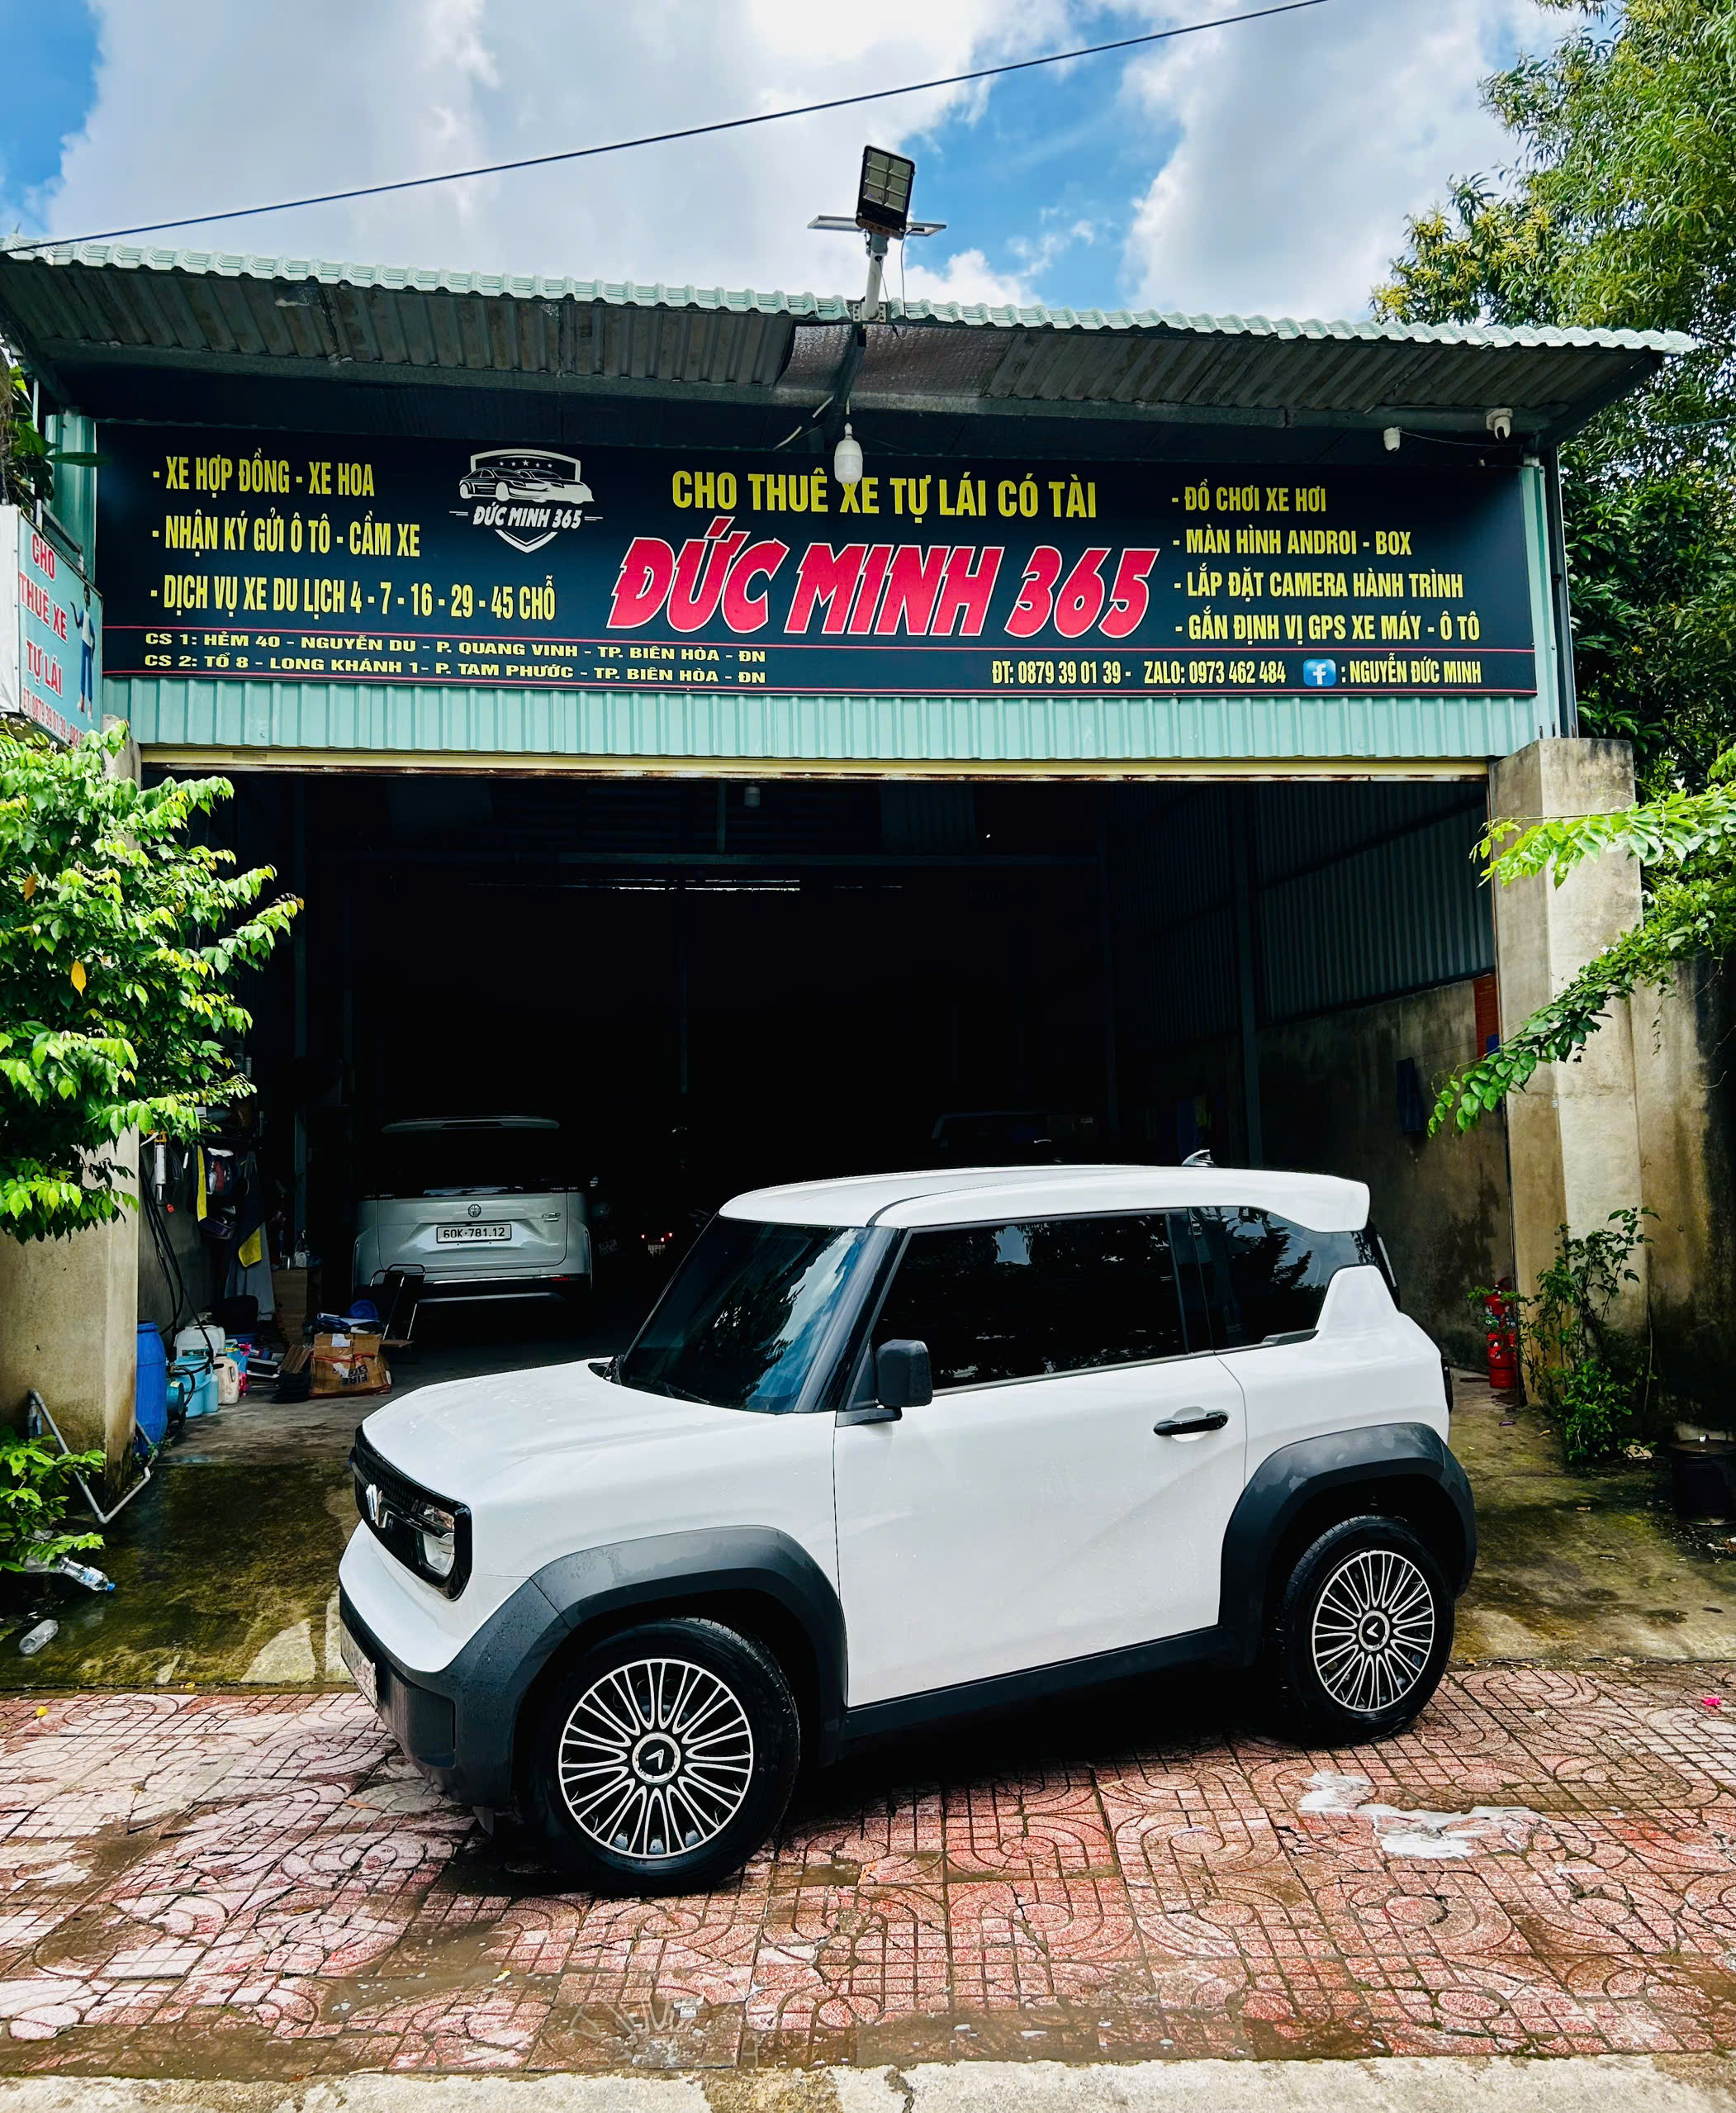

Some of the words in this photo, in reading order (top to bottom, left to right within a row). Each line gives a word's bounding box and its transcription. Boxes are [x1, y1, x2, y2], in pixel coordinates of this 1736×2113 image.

[165, 456, 190, 490] XE
[196, 454, 233, 499] HỢP
[238, 448, 290, 494] ĐỒNG
[308, 461, 332, 495] XE
[338, 463, 375, 496] HOA
[672, 470, 738, 510] CHO
[747, 467, 828, 513] THUÊ
[839, 477, 880, 515] XE
[889, 474, 932, 524] TỰ
[939, 471, 987, 516] LÁI
[998, 472, 1038, 518] CÓ
[1048, 473, 1097, 518] TÀI
[1184, 478, 1210, 511] ĐỒ
[1216, 485, 1260, 511] CHƠI
[1265, 487, 1290, 511] XE
[1295, 486, 1326, 512] HƠI
[165, 508, 219, 558] NHẬN
[224, 510, 249, 551] KÝ
[254, 506, 284, 553] GỬI
[290, 511, 303, 553] Ô
[307, 513, 330, 554] TÔ
[349, 510, 391, 556] CẦM
[396, 523, 420, 558] XE
[472, 501, 508, 526] ĐỨC
[507, 507, 552, 528] MINH
[551, 508, 583, 529] 365
[31, 532, 56, 582] CHO
[1186, 524, 1231, 554] MÀN
[1236, 524, 1282, 554] HÌNH
[1287, 529, 1357, 555] ANDROI
[1375, 530, 1412, 556] BOX
[164, 574, 208, 616] DỊCH
[213, 575, 238, 618] VỤ
[243, 577, 268, 611] XE
[273, 577, 298, 612] DU
[303, 578, 345, 620] LỊCH
[350, 581, 363, 614] 4
[380, 582, 392, 615] 7
[410, 582, 433, 617] 16
[450, 583, 473, 618] 29
[491, 586, 514, 620] 45
[519, 574, 556, 621] CHỖ
[605, 515, 790, 634] ĐỨC
[783, 542, 1006, 636] MINH
[1003, 545, 1160, 639] 365
[1187, 562, 1223, 597] LẮP
[1227, 567, 1264, 602] ĐẶT
[1269, 572, 1349, 597] CAMERA
[1353, 567, 1404, 598] HÀNH
[1408, 568, 1463, 598] TRÌNH
[19, 571, 50, 628] THUÊ
[51, 601, 68, 644] XE
[1188, 605, 1229, 640] GẮN
[1233, 615, 1280, 646] ĐỊNH
[1284, 615, 1303, 645] VỊ
[1308, 614, 1346, 640] GPS
[1351, 615, 1376, 640] XE
[1380, 610, 1421, 640] MÁY
[1440, 610, 1453, 641] Ô
[1456, 610, 1480, 641] TÔ
[145, 633, 173, 645] CS
[179, 634, 197, 645] 1:
[203, 630, 249, 647] HẺM
[254, 635, 281, 648] 40
[301, 634, 383, 651] NGUYỄN
[389, 639, 416, 652] DU
[436, 640, 453, 653] P.
[458, 642, 525, 656] QUANG
[531, 643, 578, 658] VINH
[596, 646, 624, 658] TP.
[629, 645, 675, 660] BIÊN
[681, 646, 720, 662] HÒA
[738, 650, 766, 662] ĐN
[145, 654, 172, 667] CS
[178, 655, 197, 667] 2:
[203, 652, 231, 668] TỔ
[235, 656, 249, 668] 8
[269, 657, 325, 671] LONG
[330, 658, 402, 673] KHÁNH
[409, 662, 429, 674] 1-
[435, 662, 452, 675] P.
[457, 662, 500, 677] TAM
[505, 663, 574, 678] PHƯỚC
[593, 667, 620, 680] TP.
[626, 667, 673, 681] BIÊN
[679, 667, 719, 682] HÒA
[738, 671, 766, 684] ĐN
[26, 639, 43, 686] TỰ
[44, 653, 63, 698] LÁI
[991, 660, 1014, 684] ĐT:
[1017, 660, 1055, 684] 0879
[1058, 660, 1077, 685] 39
[1080, 660, 1097, 684] 01
[1103, 660, 1122, 684] 39
[1143, 660, 1185, 684] ZALO:
[1188, 660, 1225, 684] 0973
[1228, 660, 1256, 684] 462
[1259, 660, 1287, 684] 484
[1349, 652, 1408, 684] NGUYỄN
[1410, 655, 1440, 684] ĐỨC
[1443, 660, 1482, 684] MINH
